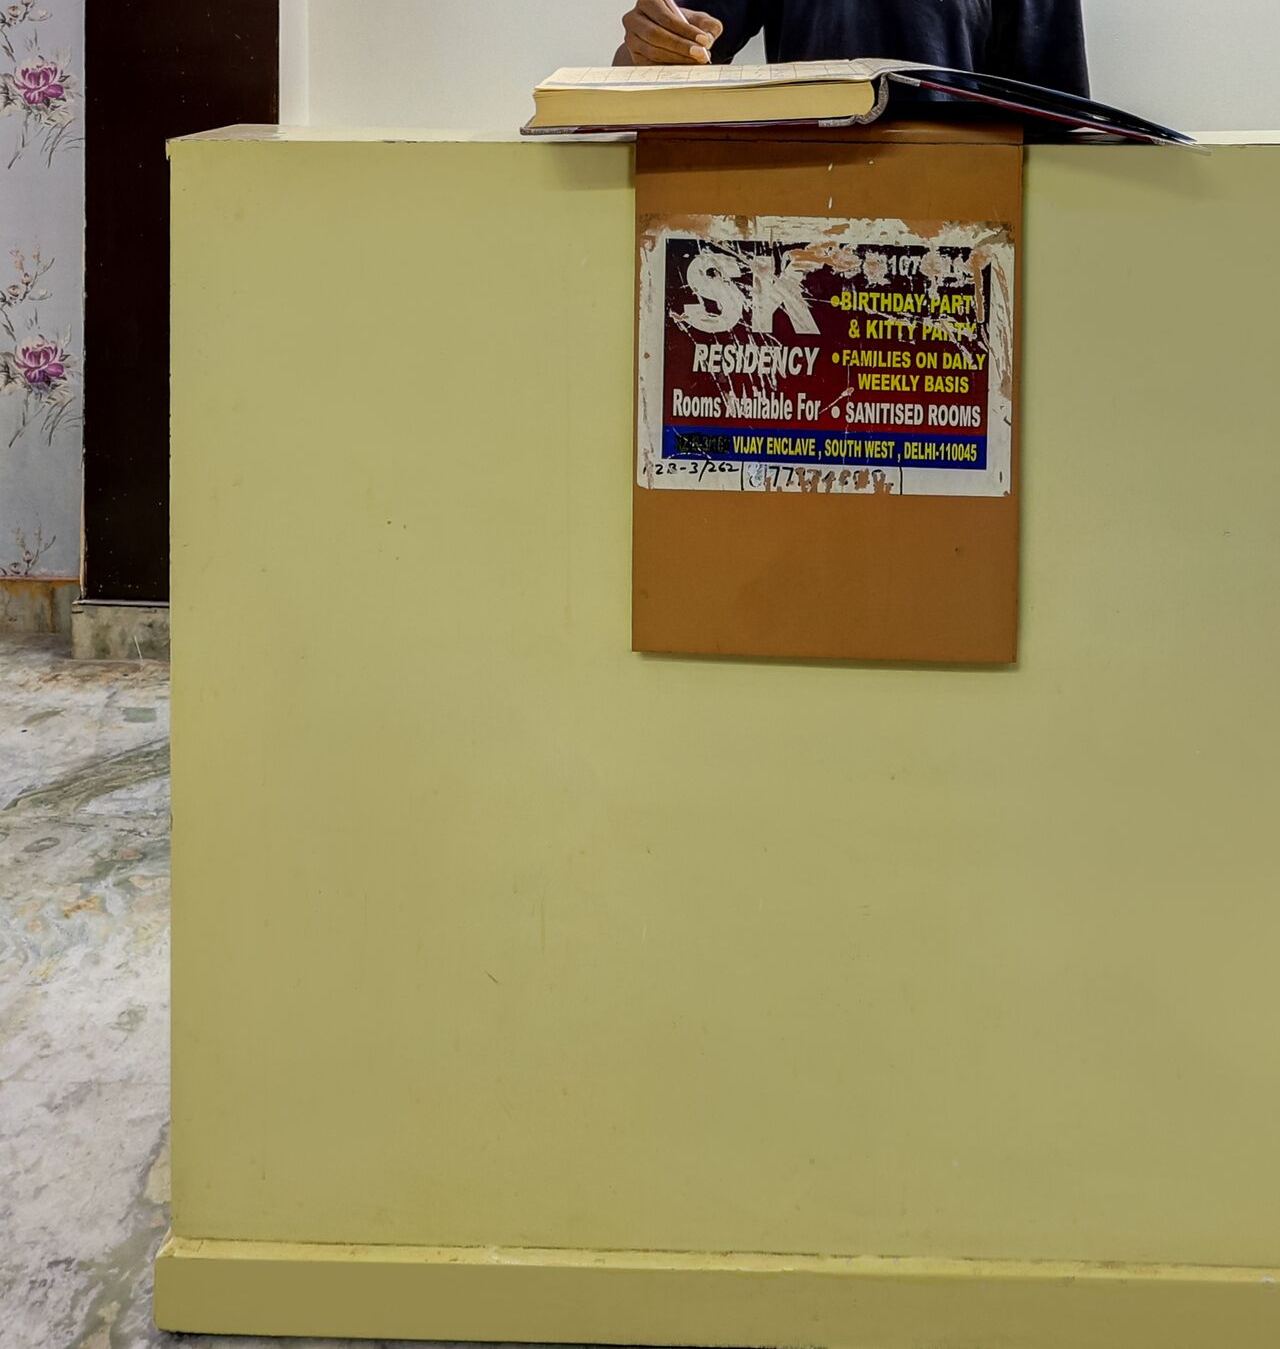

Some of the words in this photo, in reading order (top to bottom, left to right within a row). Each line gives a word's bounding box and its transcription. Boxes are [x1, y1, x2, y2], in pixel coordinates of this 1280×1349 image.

[683, 253, 821, 334] SK
[841, 292, 925, 313] BIRTHDAY
[931, 294, 977, 314] PART
[848, 319, 861, 339] &
[866, 319, 919, 341] KITTY
[692, 344, 820, 376] RESIDENCY
[842, 350, 912, 369] FAMILIES
[915, 352, 938, 369] ON
[857, 373, 920, 392] WEEKLY
[924, 375, 969, 394] BASIS
[672, 388, 721, 418] Rooms
[797, 392, 821, 421] For
[845, 401, 924, 426] SANITISED
[928, 405, 981, 427] ROOMS
[732, 435, 763, 454] VIJAY
[824, 439, 865, 457] SOUTH
[904, 443, 977, 462] DELHI-110045
